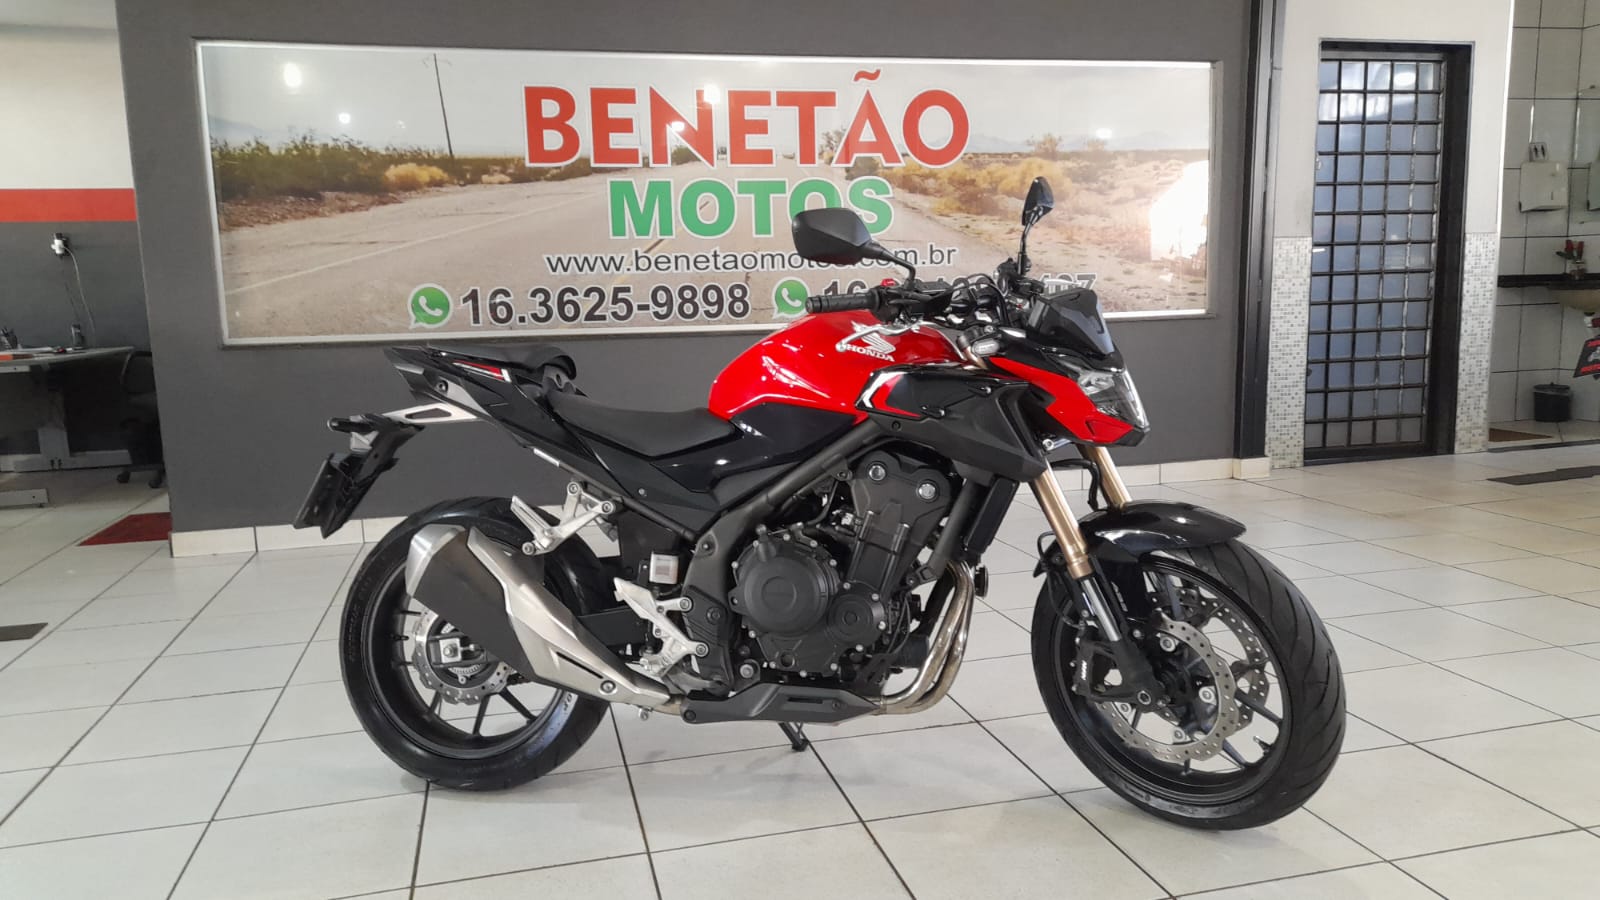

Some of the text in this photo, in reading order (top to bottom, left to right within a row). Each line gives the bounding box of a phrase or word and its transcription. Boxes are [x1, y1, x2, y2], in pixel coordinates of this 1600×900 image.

[523, 69, 970, 168] BENETÃO
[609, 177, 894, 237] MOTOS
[546, 244, 957, 273] www.benetaomom.br
[461, 283, 751, 325] 16.3625-9898
[845, 343, 896, 362] HONDA
